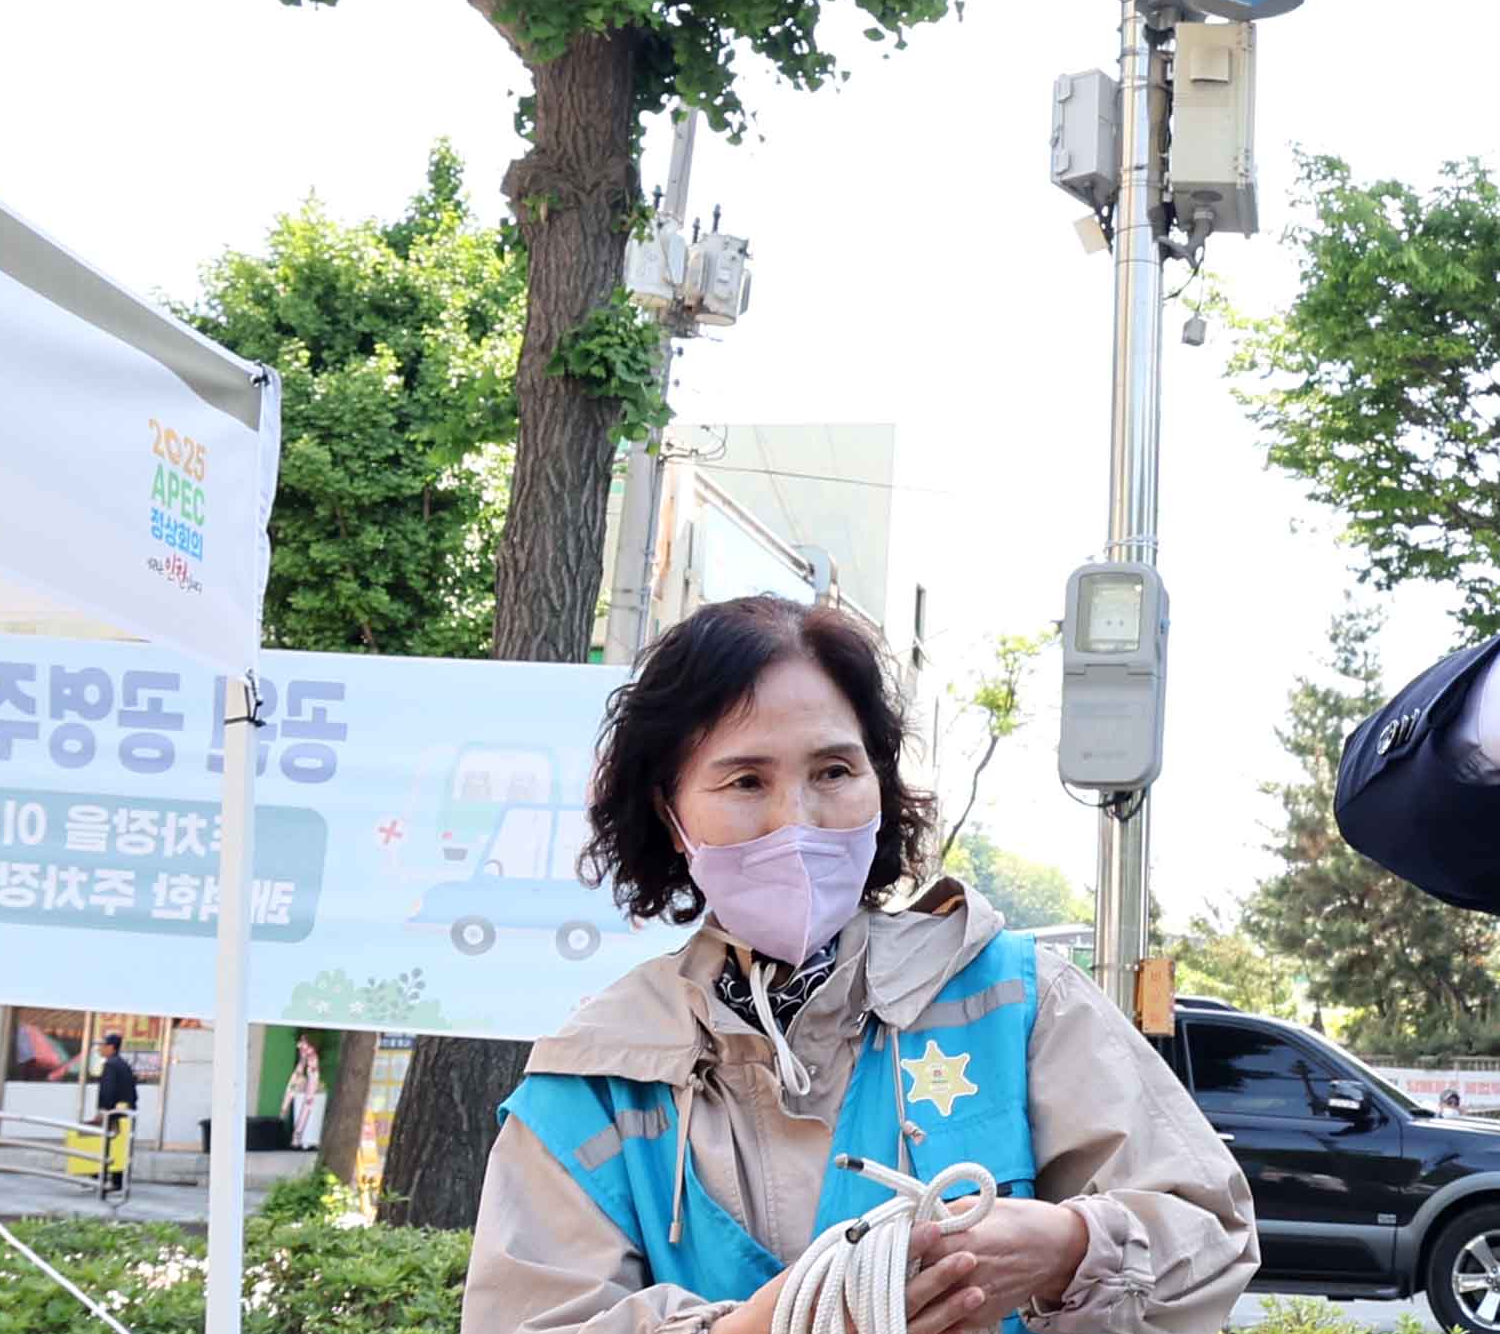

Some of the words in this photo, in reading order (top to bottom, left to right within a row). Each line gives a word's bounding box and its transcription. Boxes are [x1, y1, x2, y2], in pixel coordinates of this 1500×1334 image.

[149, 418, 205, 483] 2025
[152, 463, 205, 526] APEC
[151, 507, 203, 561] 정상회의
